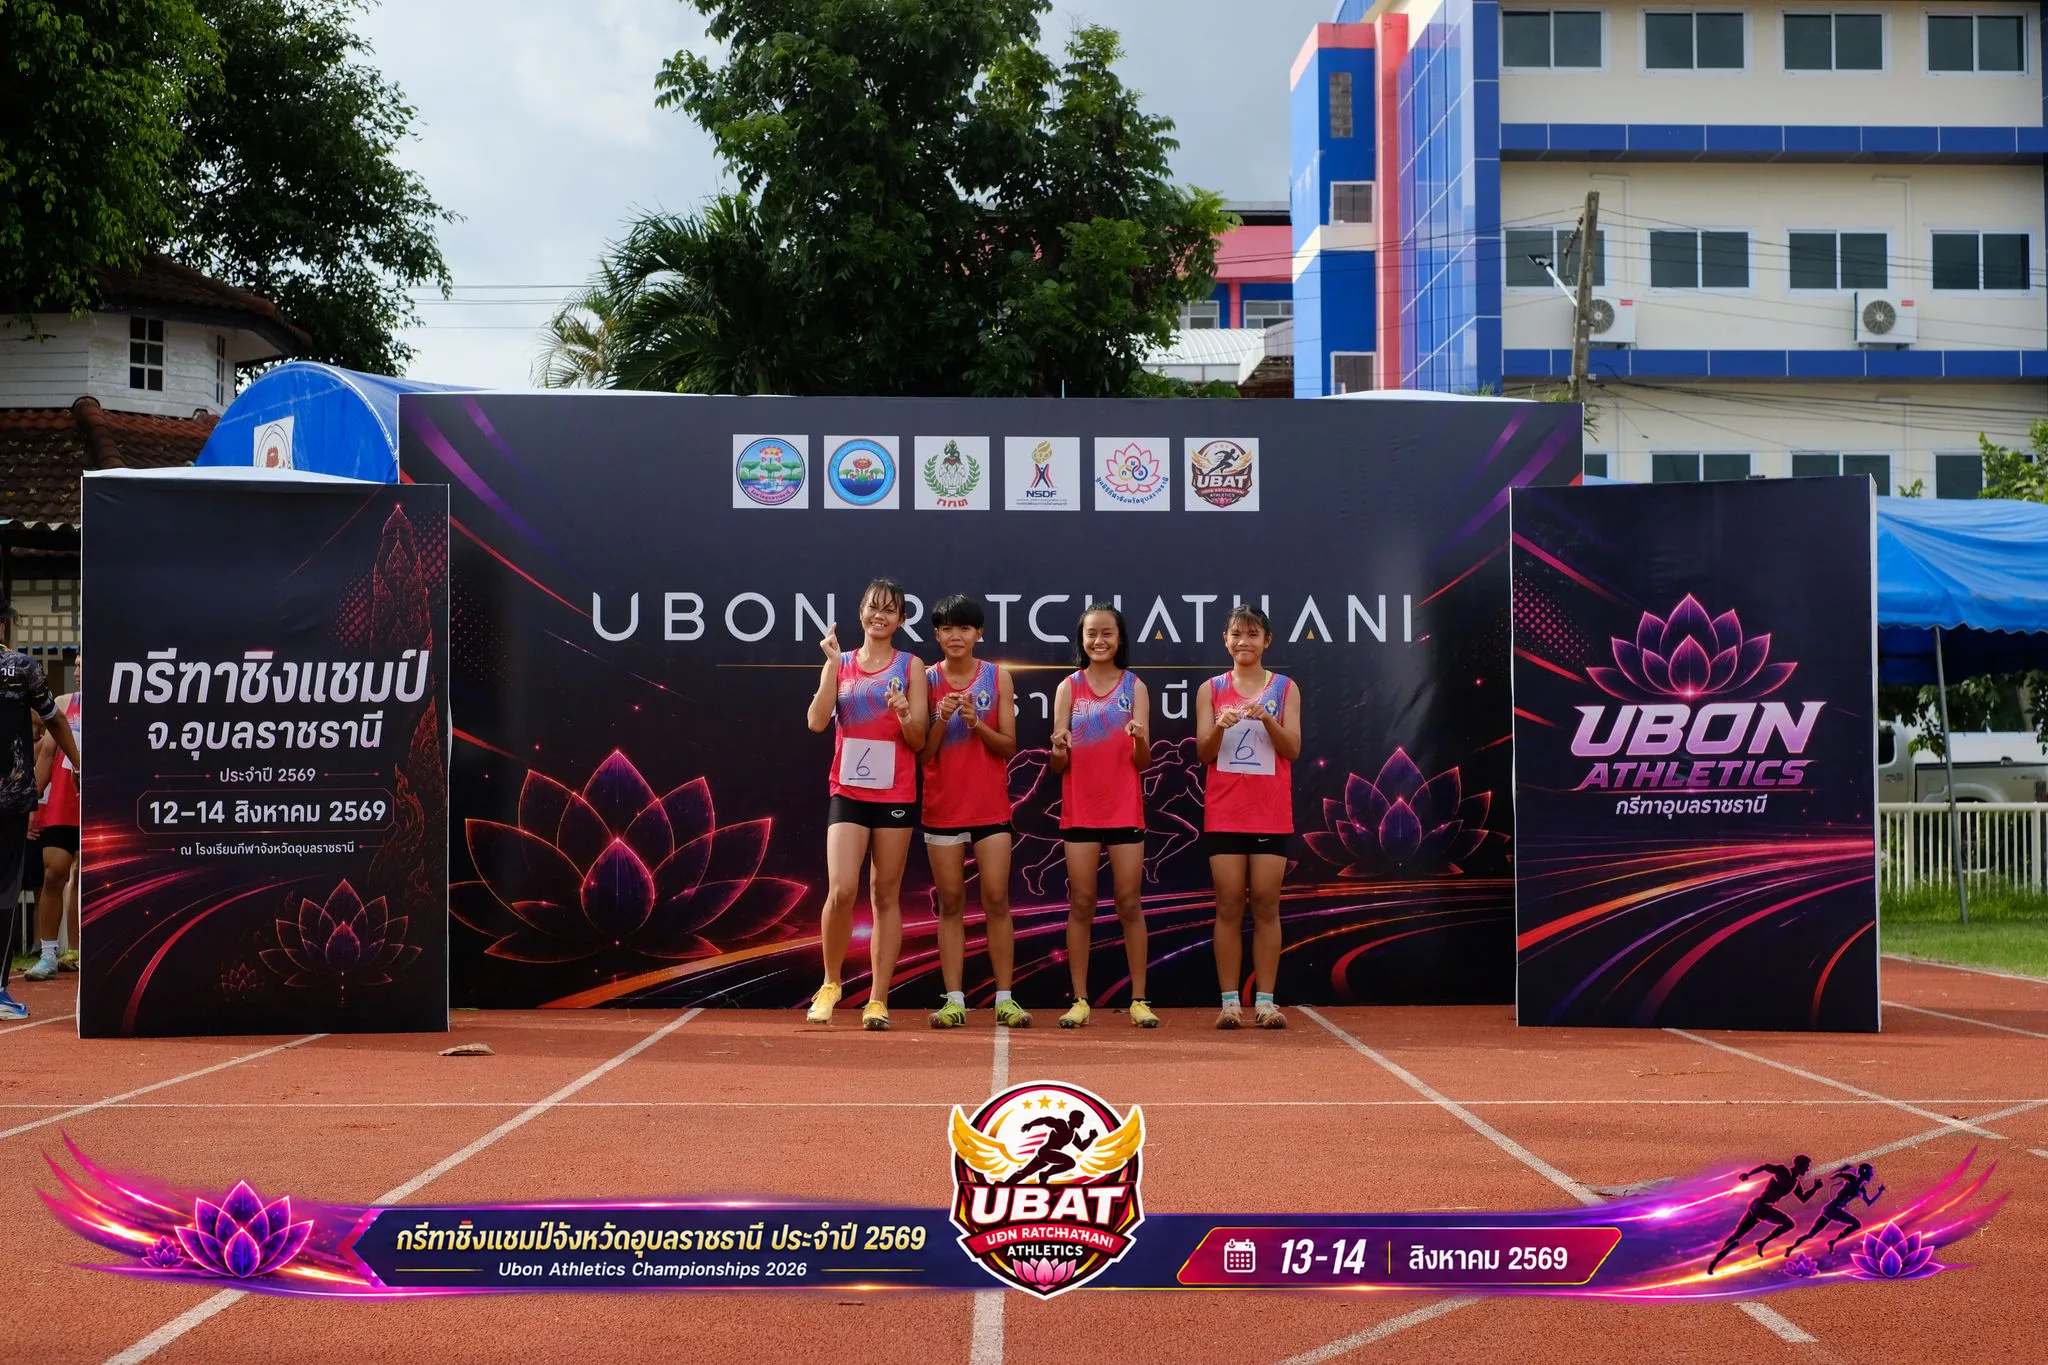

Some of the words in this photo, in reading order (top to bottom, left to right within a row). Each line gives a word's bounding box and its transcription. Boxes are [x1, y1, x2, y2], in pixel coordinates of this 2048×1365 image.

[1026, 490, 1057, 498] NSDF
[1196, 475, 1248, 488] UBAT
[592, 591, 836, 642] UBON
[108, 647, 430, 704] กรีฑาชิงแชมป์
[147, 711, 384, 761] จ.อุบลราชธานี
[1570, 701, 1828, 757] UBON
[1235, 728, 1255, 761] 6
[219, 767, 273, 783] ประจำปี
[277, 768, 317, 783] 2569
[855, 747, 871, 777] 6
[1575, 760, 1812, 789] ATHLETICS
[234, 799, 321, 824] สิงหาคม
[329, 800, 387, 822] 2569
[1615, 793, 1768, 820] กรีฑาอุบลราชธานี
[180, 846, 192, 855] ณ
[195, 840, 355, 857] โรงเรียนกีฬาจังหวัดอุบลราชธานี
